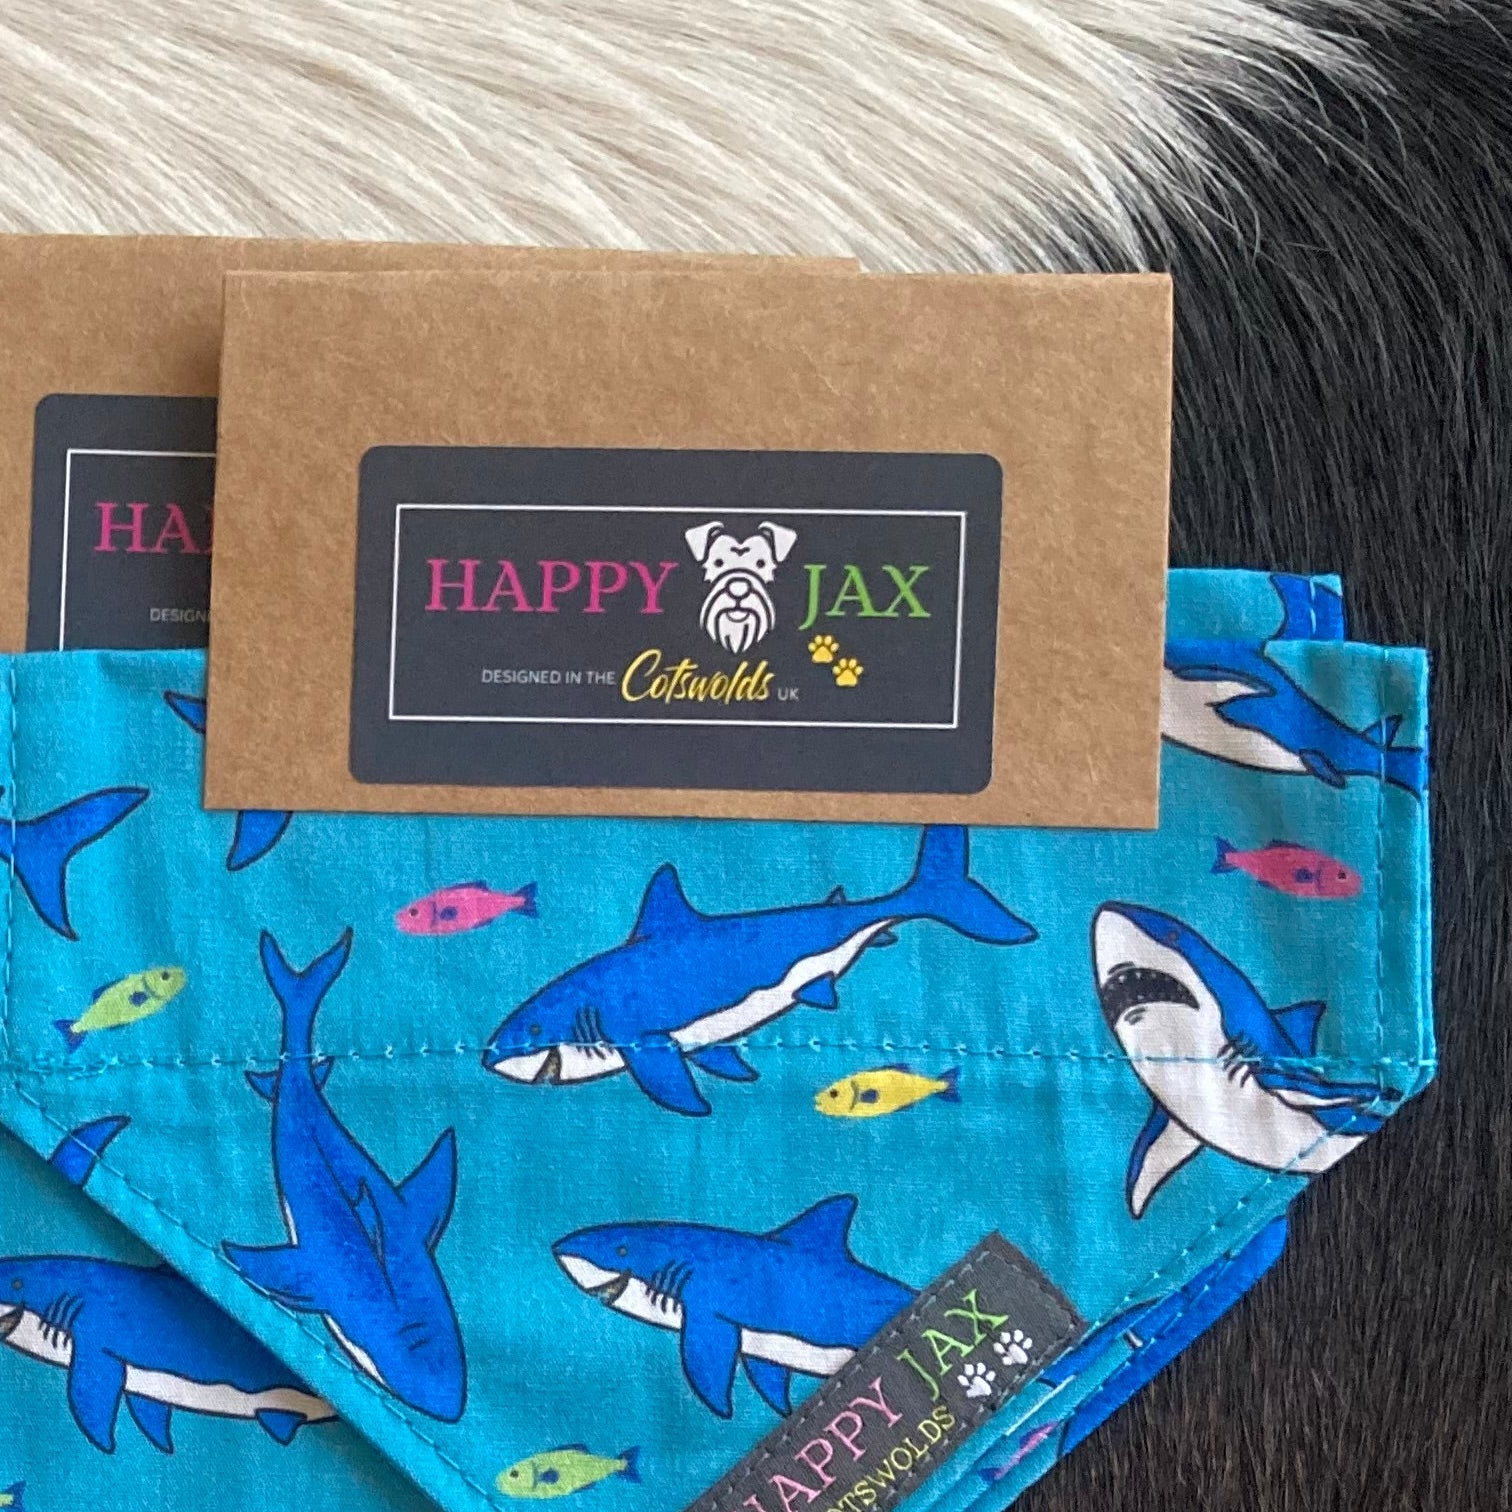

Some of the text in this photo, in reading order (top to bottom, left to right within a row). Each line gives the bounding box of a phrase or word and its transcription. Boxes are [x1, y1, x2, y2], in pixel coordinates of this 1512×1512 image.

[94, 501, 214, 554] HA
[149, 607, 210, 622] DESIGN
[425, 558, 931, 630] HAPPY JAX
[481, 648, 799, 705] DESIGNED IN THE Cotswolds UK
[896, 1289, 1009, 1401] JAX
